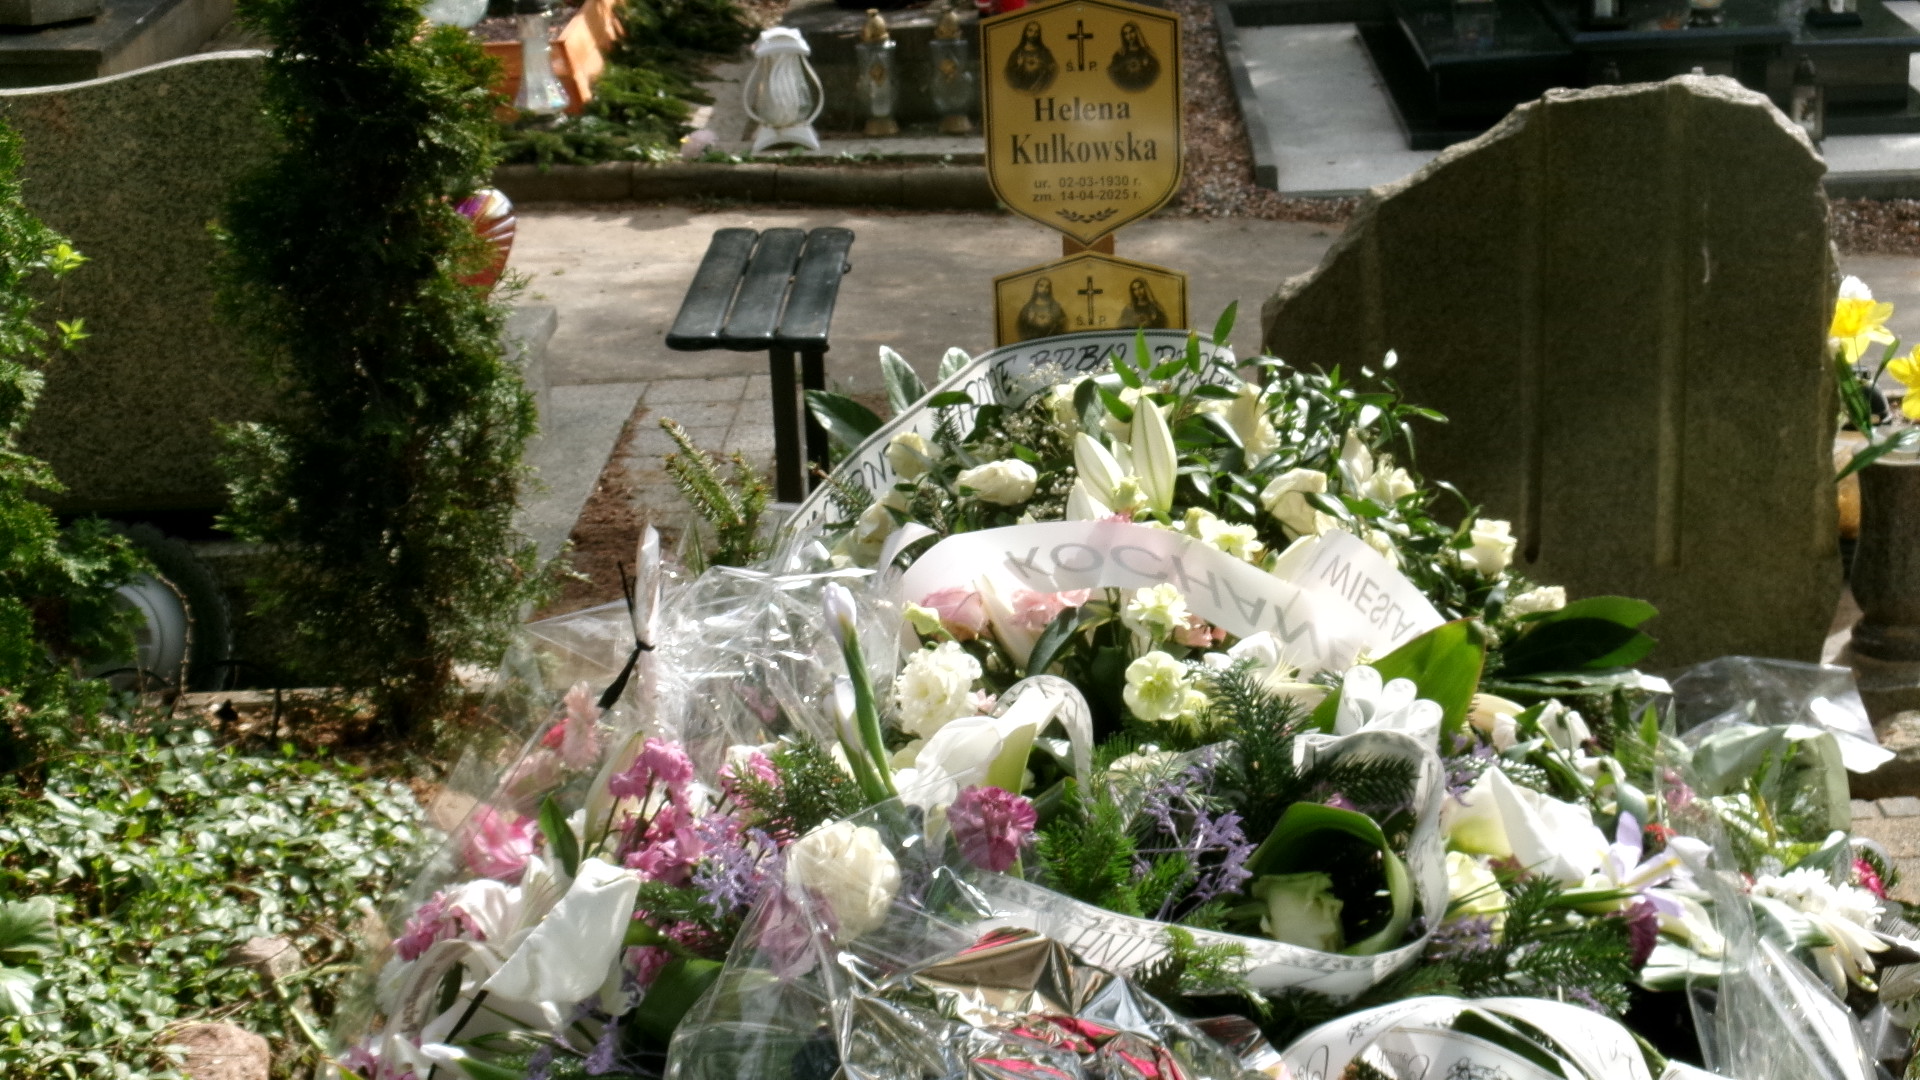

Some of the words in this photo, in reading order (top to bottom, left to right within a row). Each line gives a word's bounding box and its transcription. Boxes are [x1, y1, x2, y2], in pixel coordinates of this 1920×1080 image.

[1033, 97, 1131, 121] Helena
[1011, 132, 1158, 165] Kulkowska
[1034, 179, 1050, 189] ur.
[1058, 175, 1129, 188] 02-03-1930
[1032, 193, 1055, 202] zm.
[1060, 189, 1130, 201] 14-04-2025
